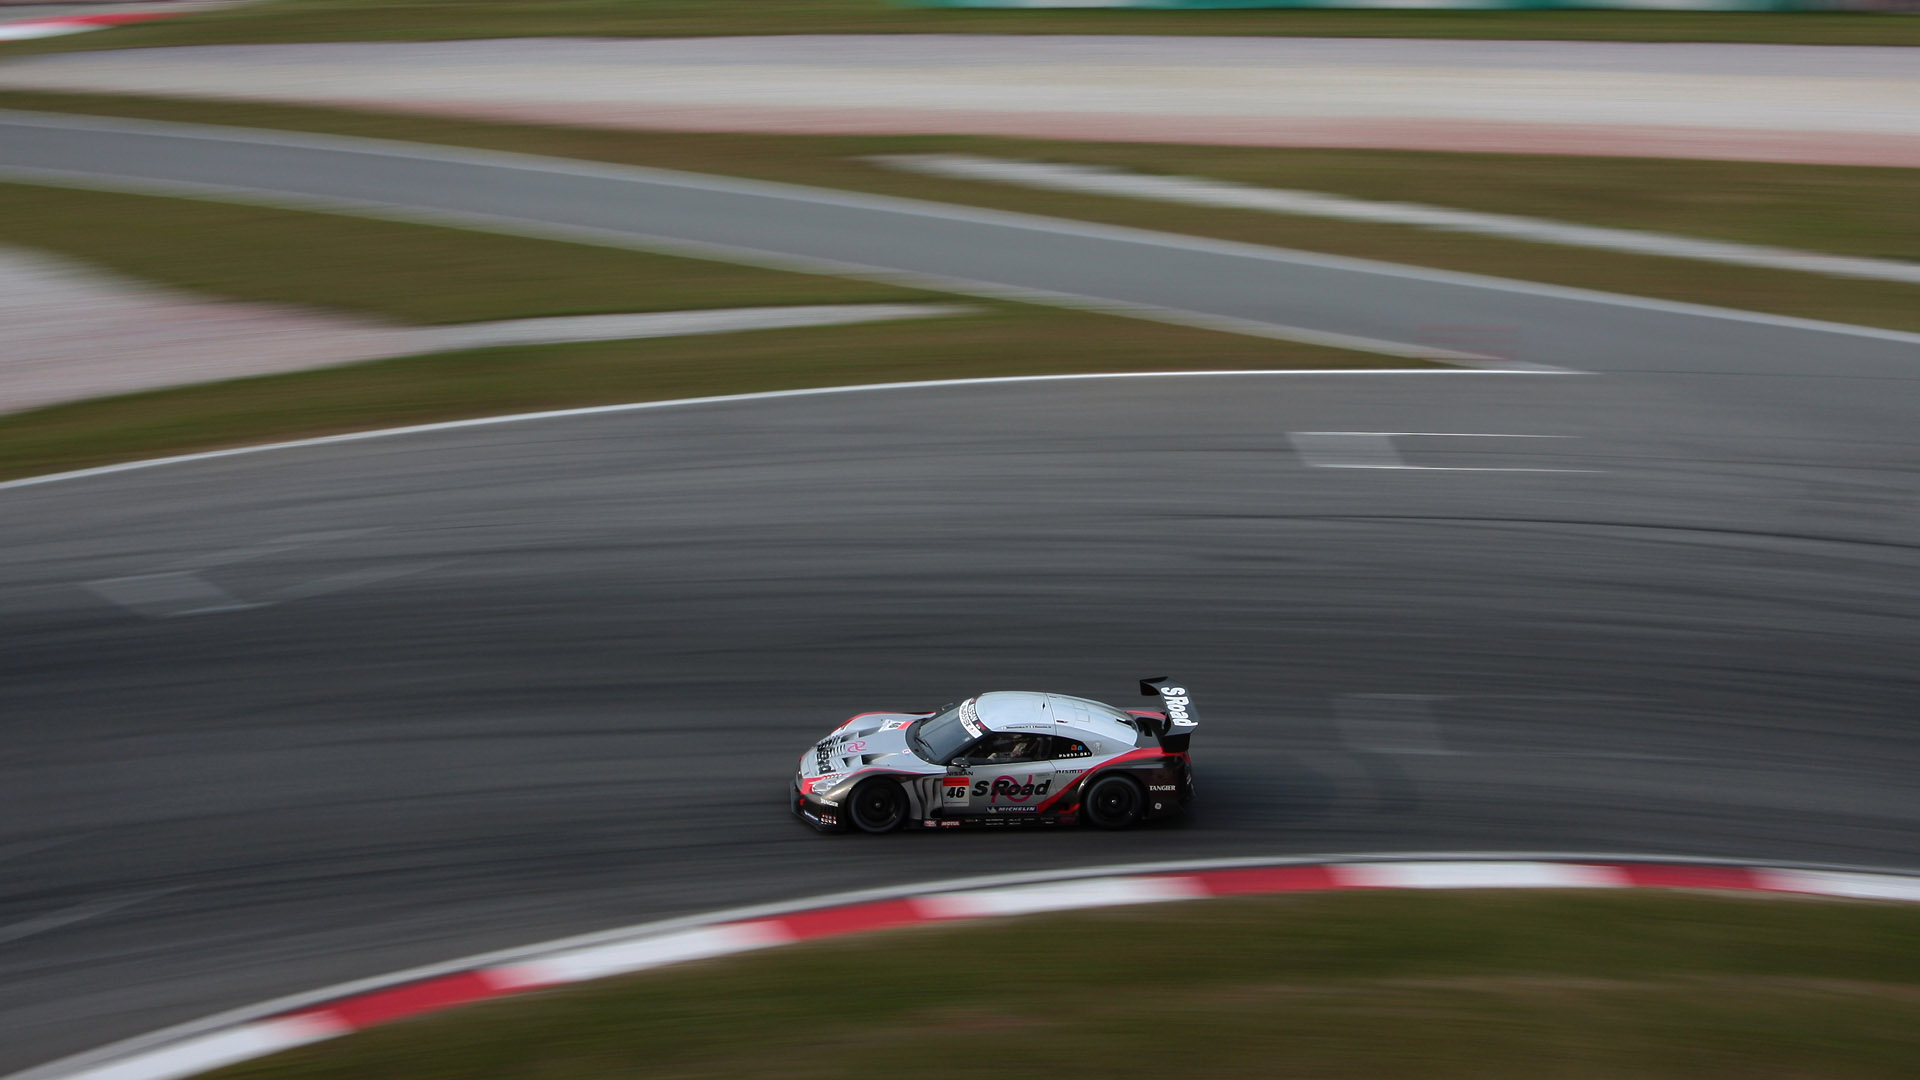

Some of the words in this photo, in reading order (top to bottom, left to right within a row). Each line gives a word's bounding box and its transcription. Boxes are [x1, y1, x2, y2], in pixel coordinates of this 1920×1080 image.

[1160, 686, 1186, 696] S
[1163, 695, 1199, 727] Road
[946, 786, 966, 799] 46
[971, 780, 990, 797] S
[990, 779, 1052, 797] Road
